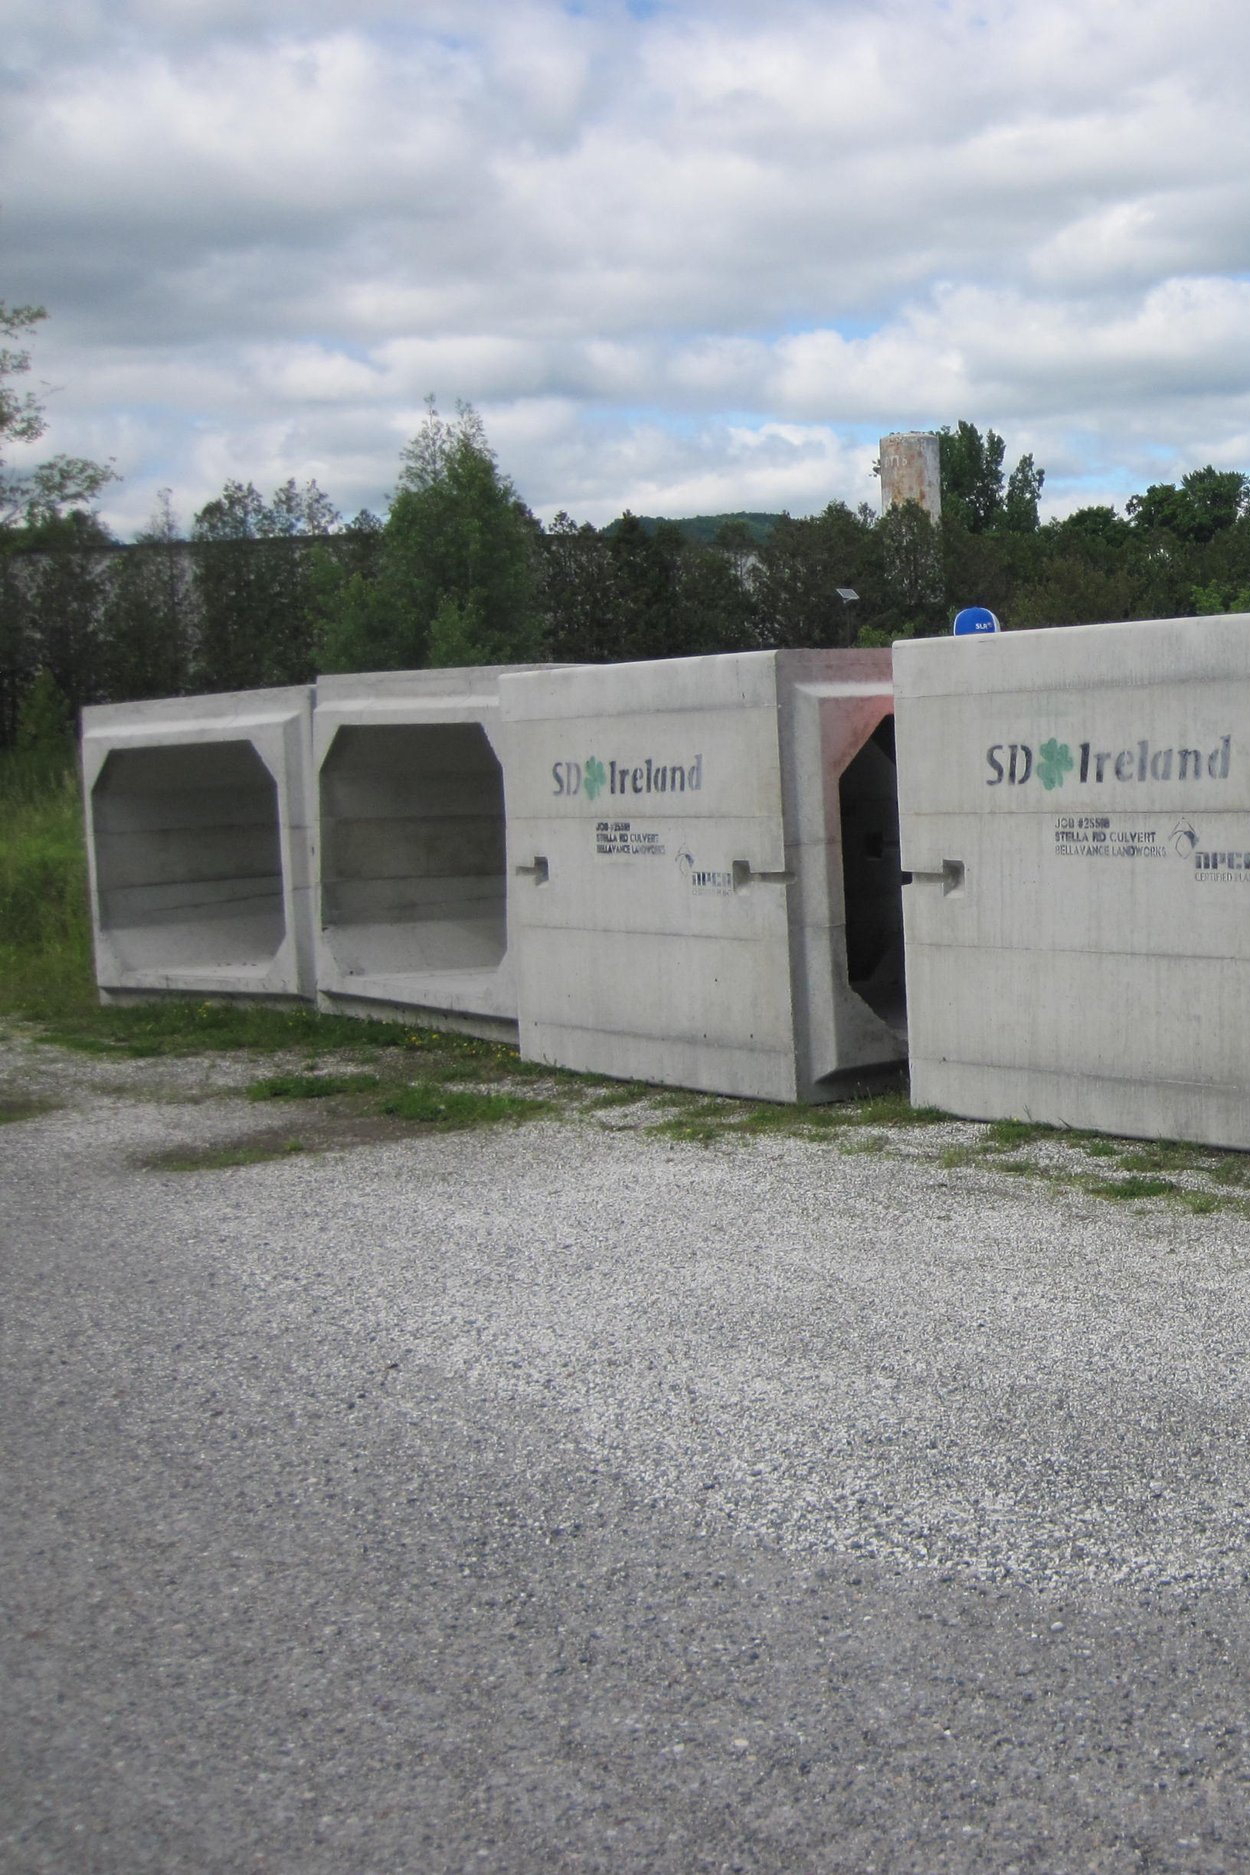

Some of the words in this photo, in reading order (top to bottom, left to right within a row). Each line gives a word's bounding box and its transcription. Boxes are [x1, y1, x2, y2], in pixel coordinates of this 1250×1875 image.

[986, 744, 1033, 786] SD
[1079, 734, 1231, 783] Ireland
[552, 762, 582, 796] SD
[609, 753, 703, 794] Ireland
[1055, 817, 1074, 829] JOB
[1055, 831, 1089, 842] STELLA
[1092, 831, 1106, 842] RD
[1110, 831, 1156, 843] CULVERT
[1055, 845, 1109, 856] BELLAVANCE
[1112, 845, 1166, 857] LANDWORKS
